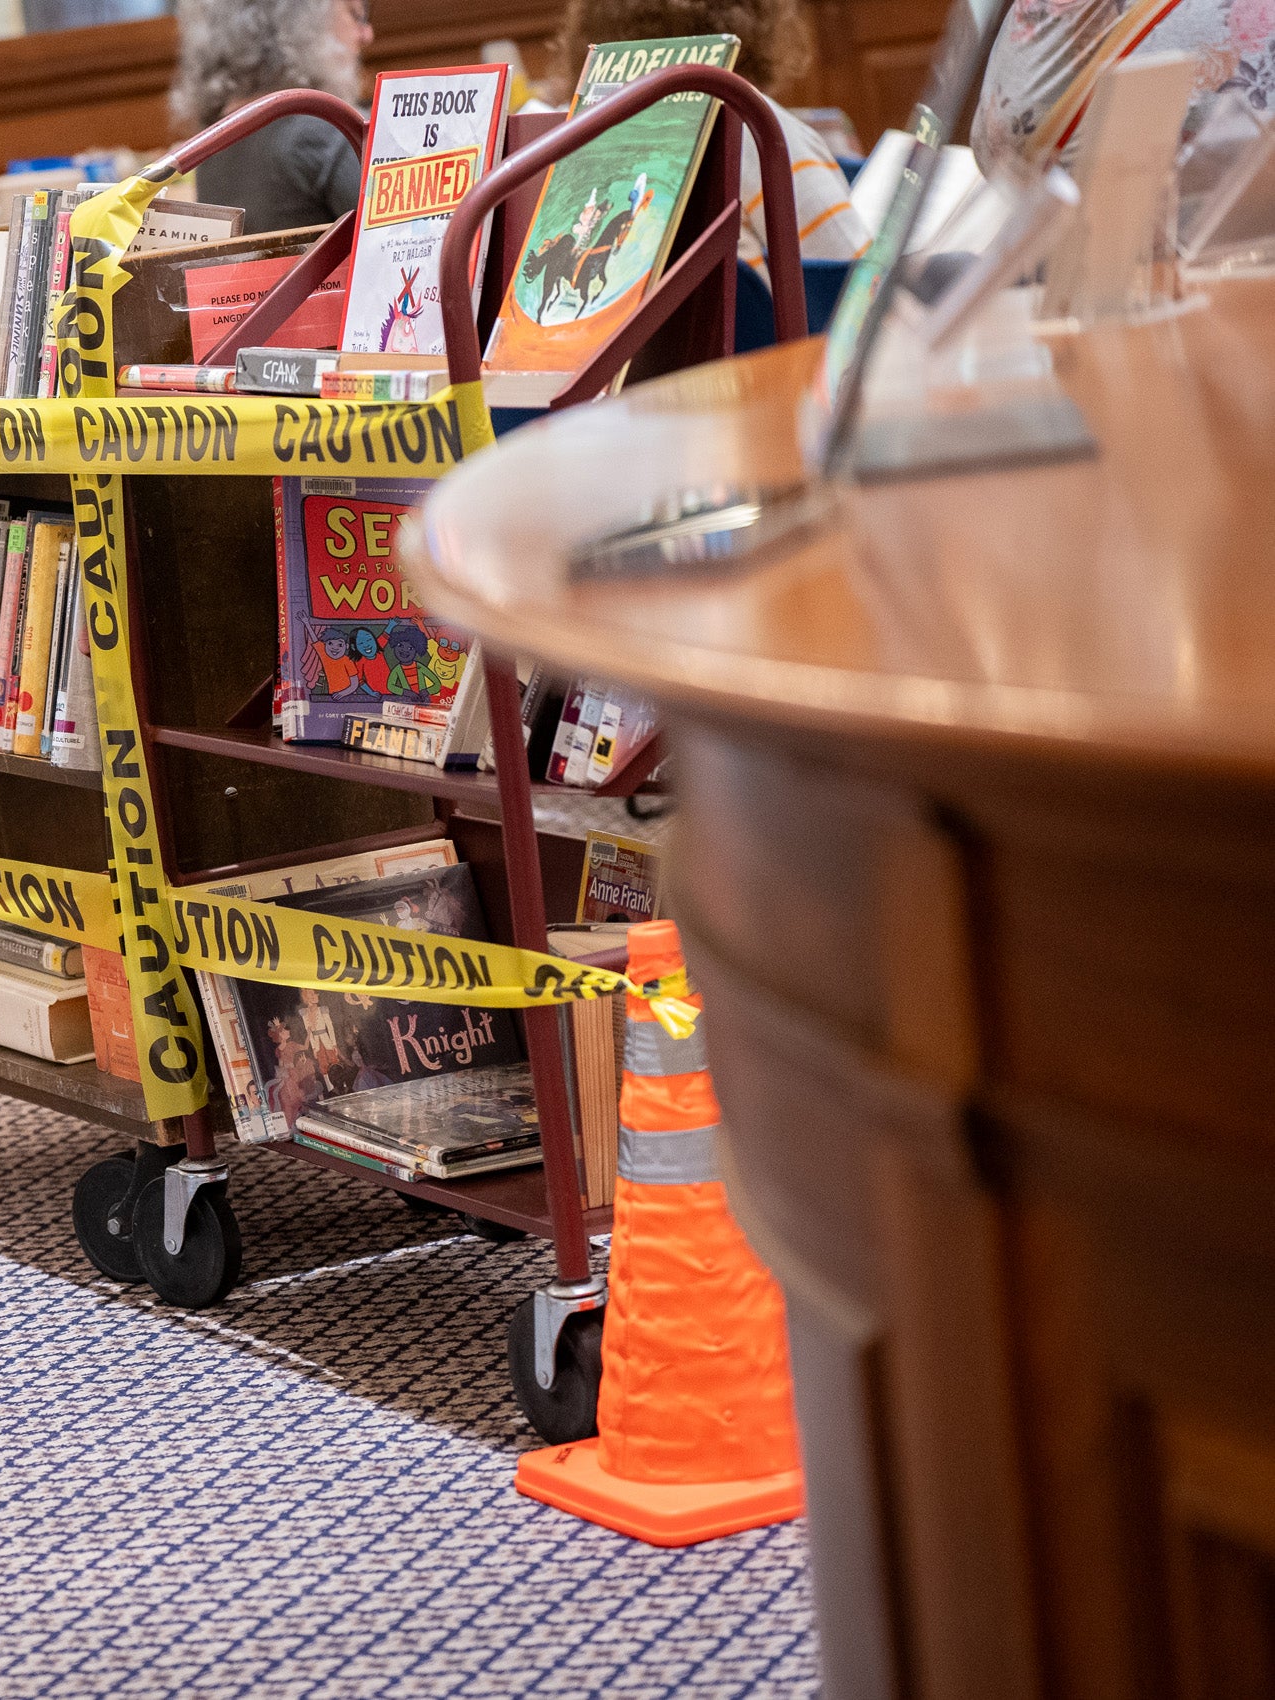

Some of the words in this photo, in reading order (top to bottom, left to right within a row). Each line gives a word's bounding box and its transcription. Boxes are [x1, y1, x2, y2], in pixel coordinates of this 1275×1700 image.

[393, 92, 428, 117] THIS
[431, 89, 478, 115] BOOK
[422, 124, 439, 147] IS
[376, 158, 470, 215] BANNED
[392, 250, 405, 263] RAJ
[211, 294, 241, 305] PLEASE
[243, 292, 256, 301] DO
[74, 405, 239, 462] CAUTION
[272, 399, 464, 465] CAUTION
[325, 506, 417, 559] SE
[336, 563, 350, 574] IS
[358, 563, 368, 573] A
[320, 575, 423, 612] WOR
[105, 729, 198, 1086] CAUTION
[588, 875, 620, 905] Anne
[620, 883, 652, 914] Frank
[173, 900, 281, 972] UTION
[312, 922, 494, 990] CAUTION
[386, 1007, 496, 1075] Knight
